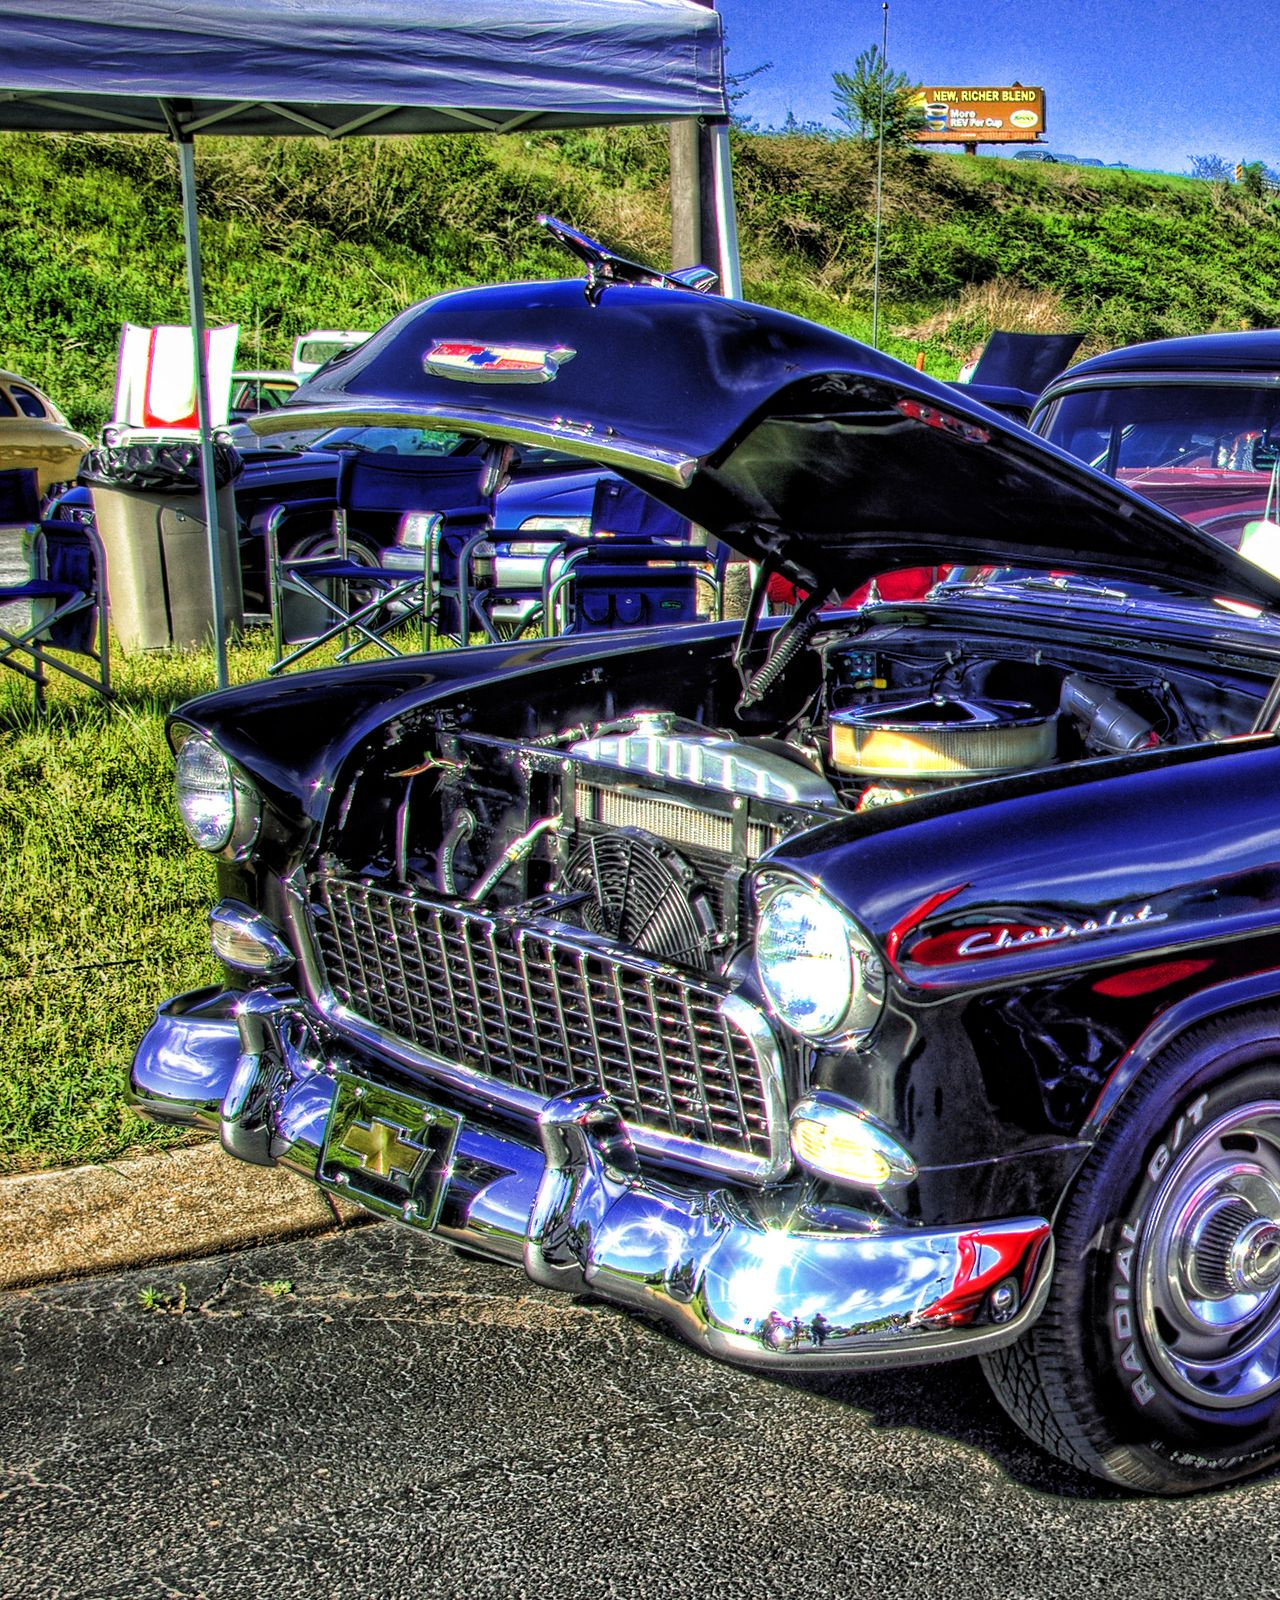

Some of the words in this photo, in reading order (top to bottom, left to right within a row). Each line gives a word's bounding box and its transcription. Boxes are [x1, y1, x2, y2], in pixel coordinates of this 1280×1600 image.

[933, 91, 959, 103] NEW,
[961, 91, 1000, 102] RICHER
[1002, 91, 1036, 102] BLEND
[950, 109, 976, 119] More
[969, 118, 985, 128] Per
[985, 117, 1003, 129] Cup
[957, 904, 1169, 956] Chevrolet
[1113, 1218, 1156, 1407] RADIAL
[1147, 1092, 1210, 1182] G/T
